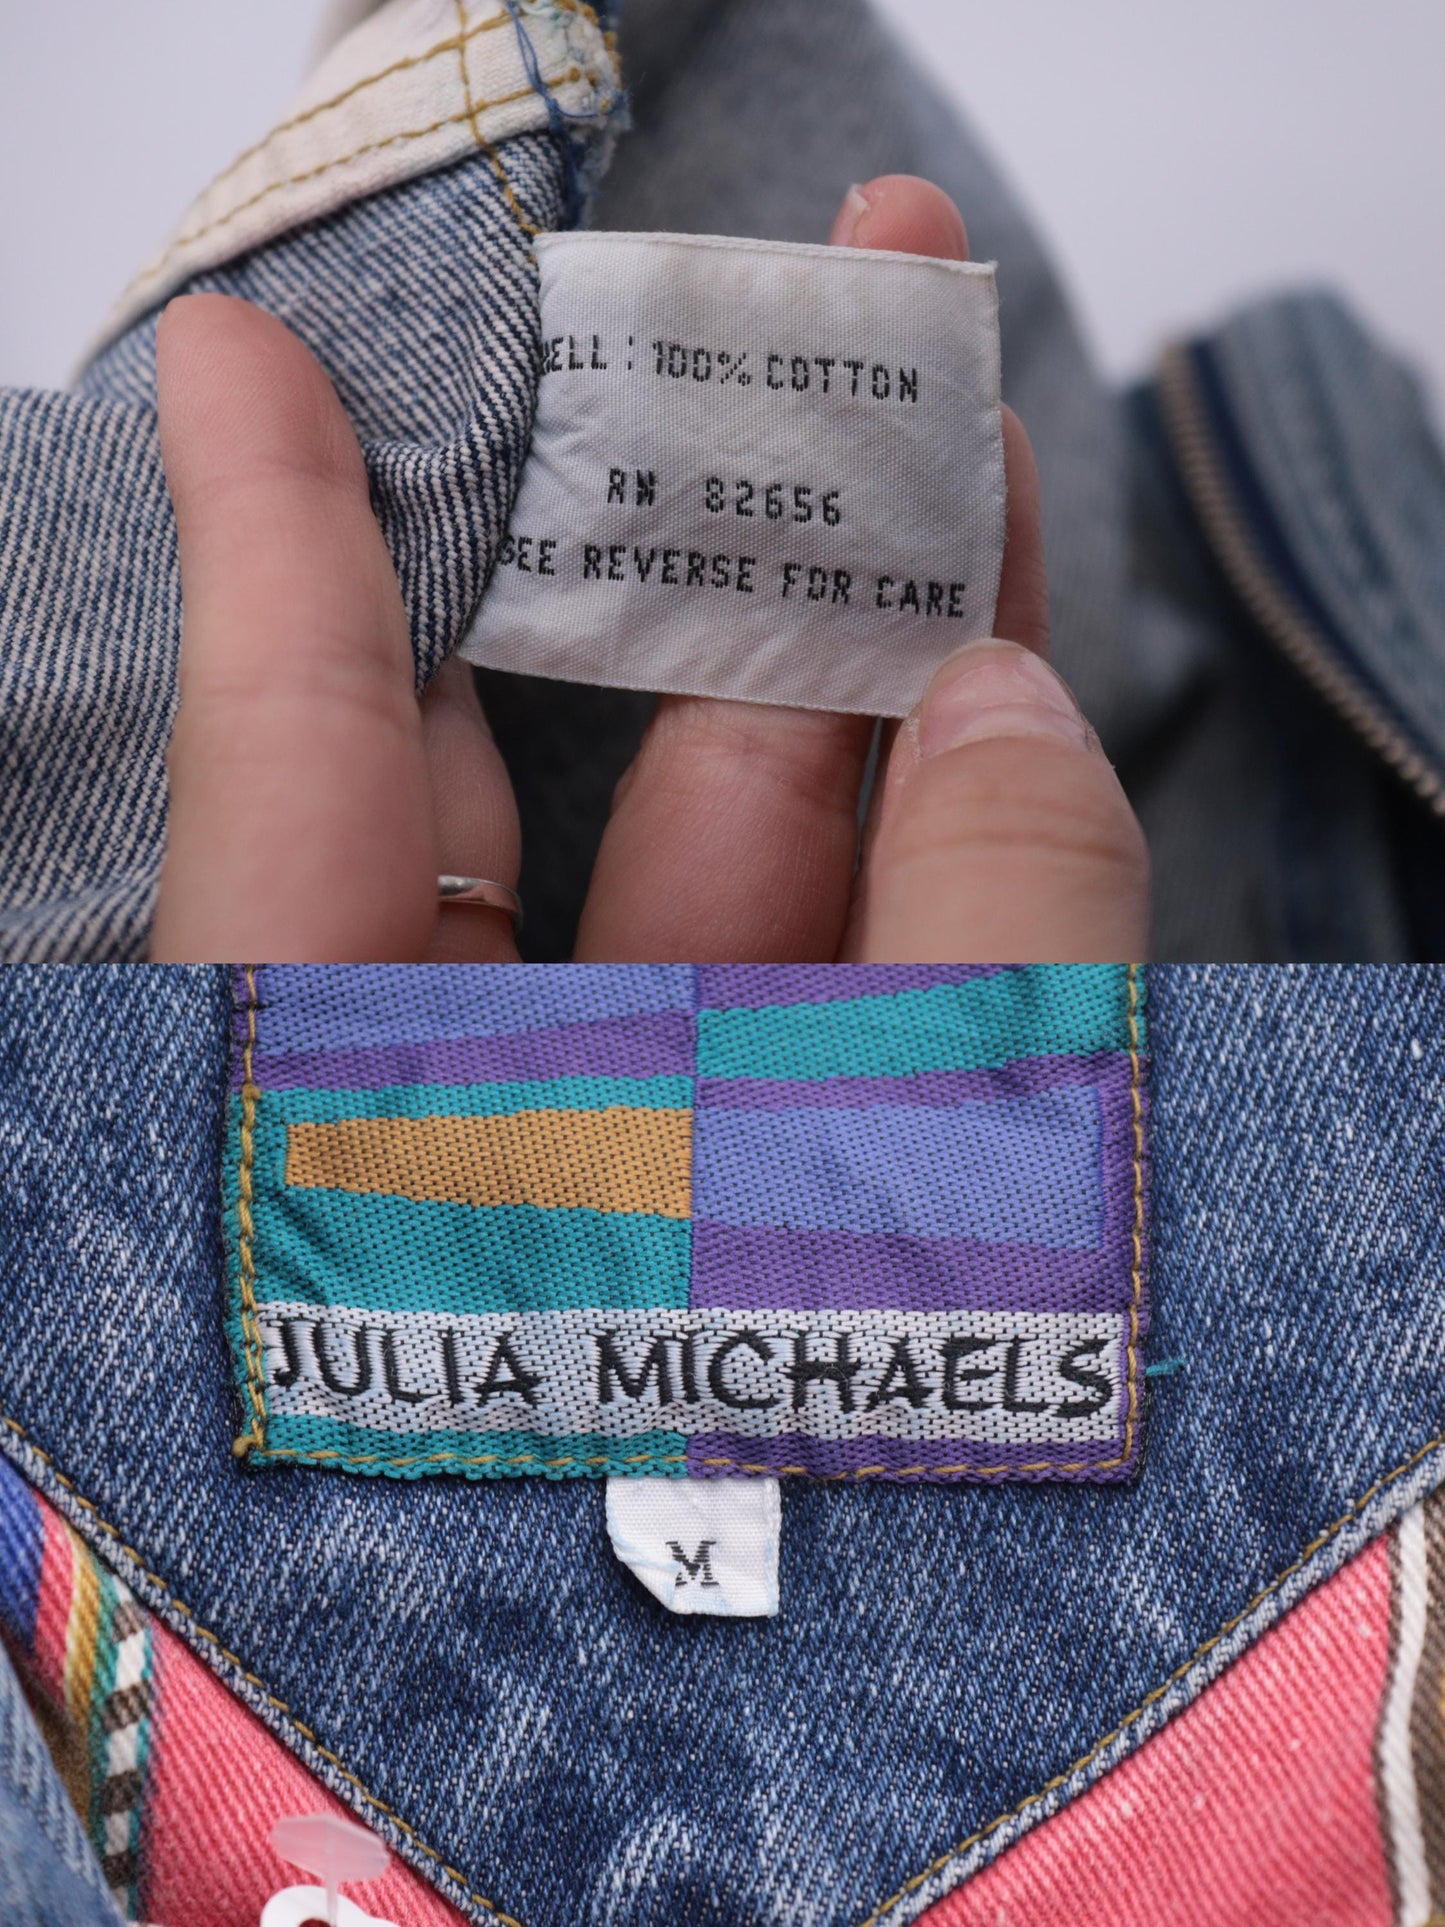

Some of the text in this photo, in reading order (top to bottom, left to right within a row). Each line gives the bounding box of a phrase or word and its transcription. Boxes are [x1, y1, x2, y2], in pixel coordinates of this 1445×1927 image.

[651, 340, 752, 387] 100%
[766, 354, 919, 403] COTTON
[606, 468, 842, 526] RN 82656
[583, 544, 756, 593] REVERSE
[782, 563, 852, 604] FOR
[876, 575, 967, 619] CARE
[275, 1318, 1117, 1420] JULIA MICHAELS
[667, 1541, 718, 1590] M
